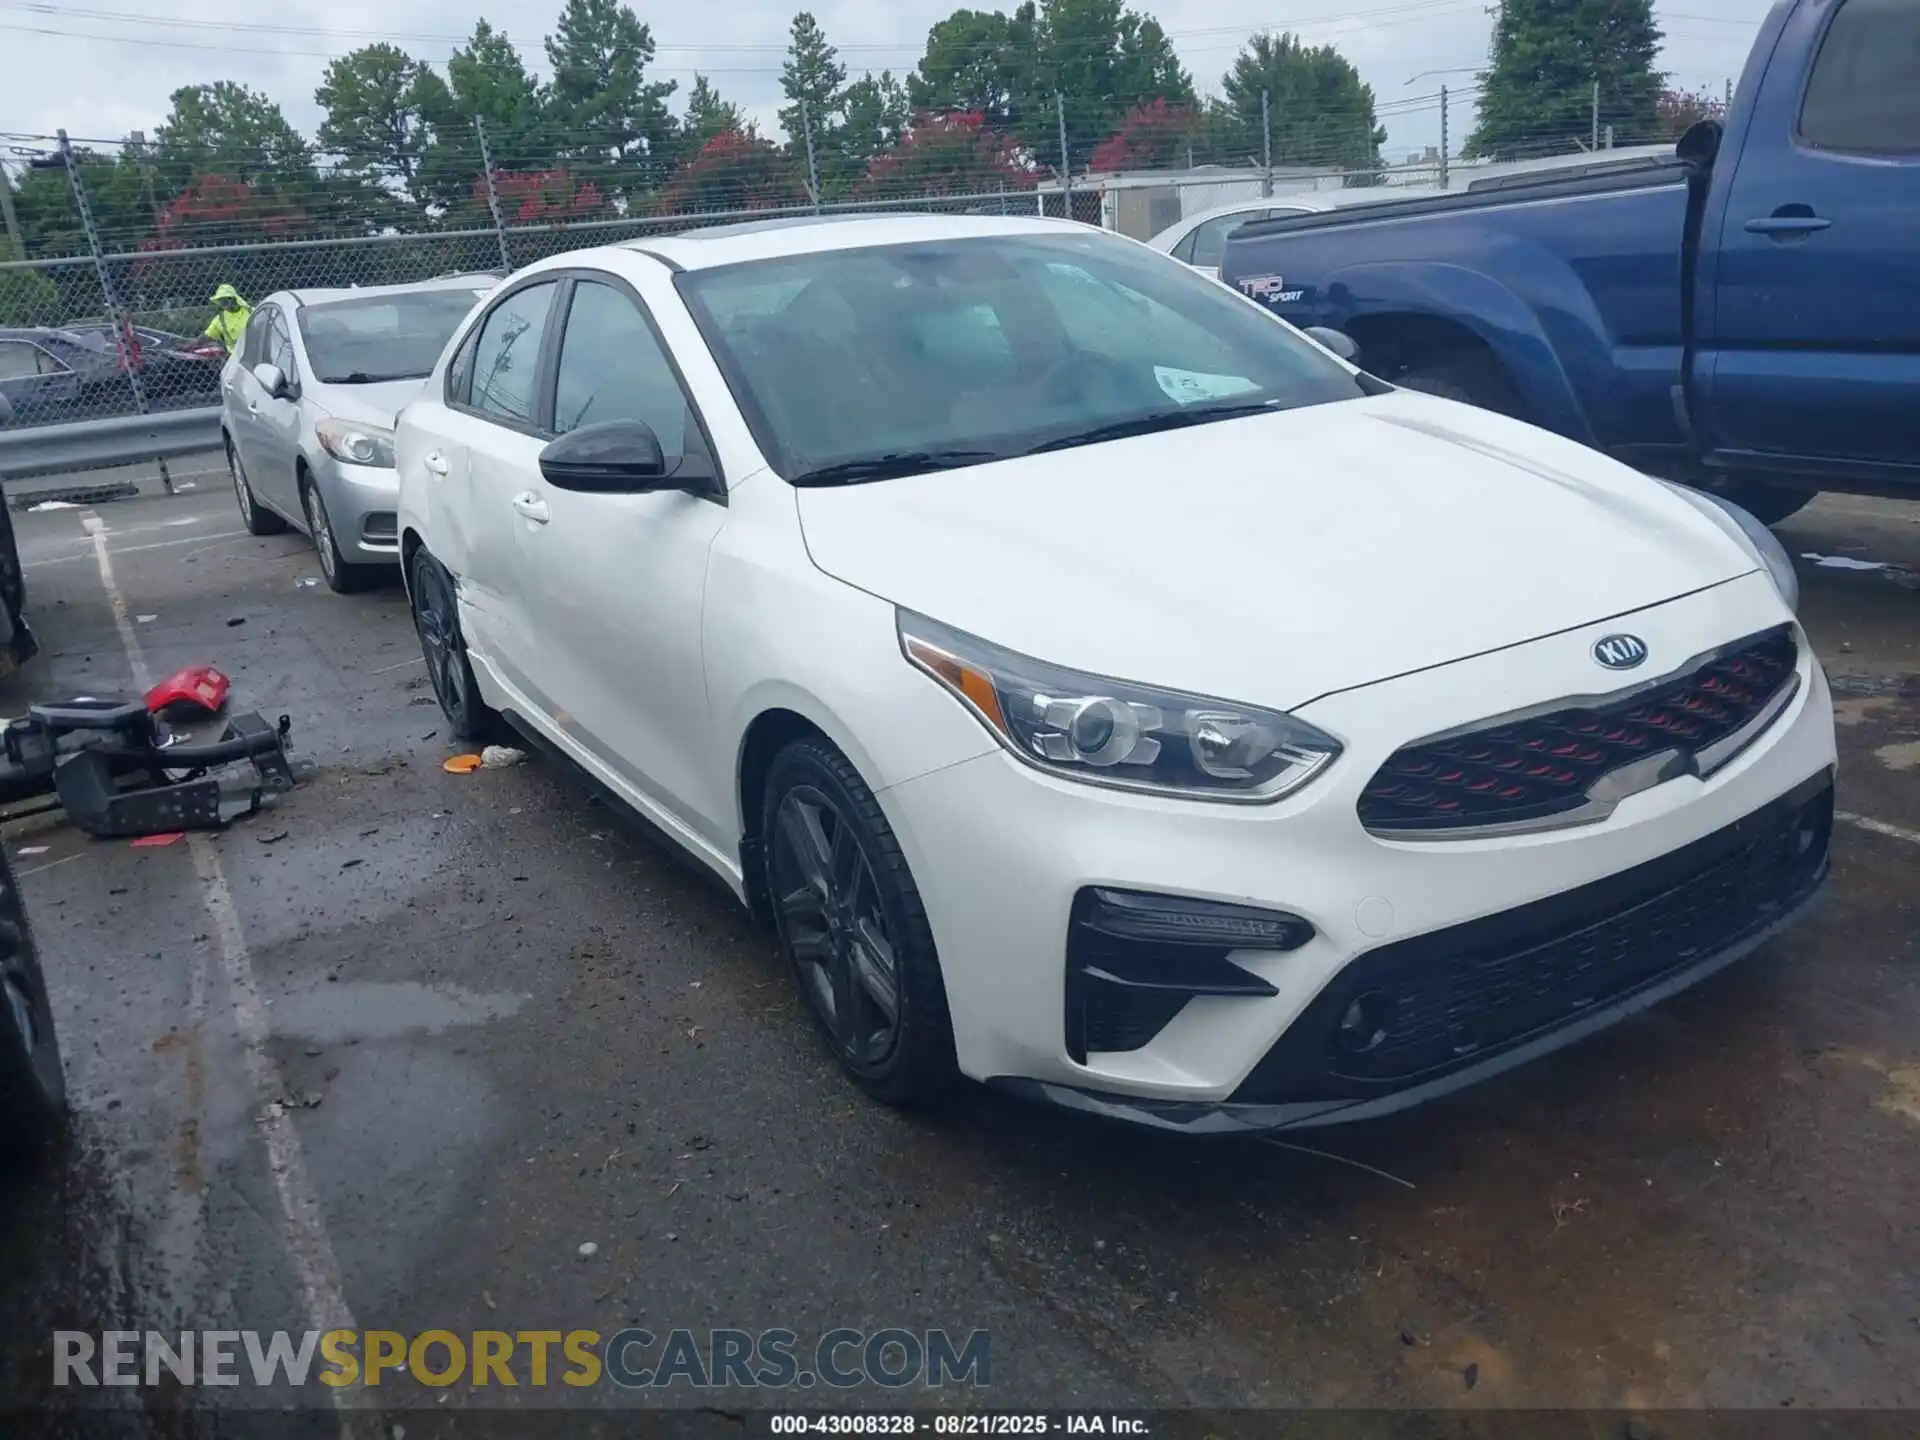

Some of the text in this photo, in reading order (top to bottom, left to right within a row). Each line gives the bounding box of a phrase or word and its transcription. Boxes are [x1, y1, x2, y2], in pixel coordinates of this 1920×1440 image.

[1239, 276, 1283, 298] TRD
[1267, 290, 1304, 302] SPORT
[1598, 636, 1644, 664] KIA
